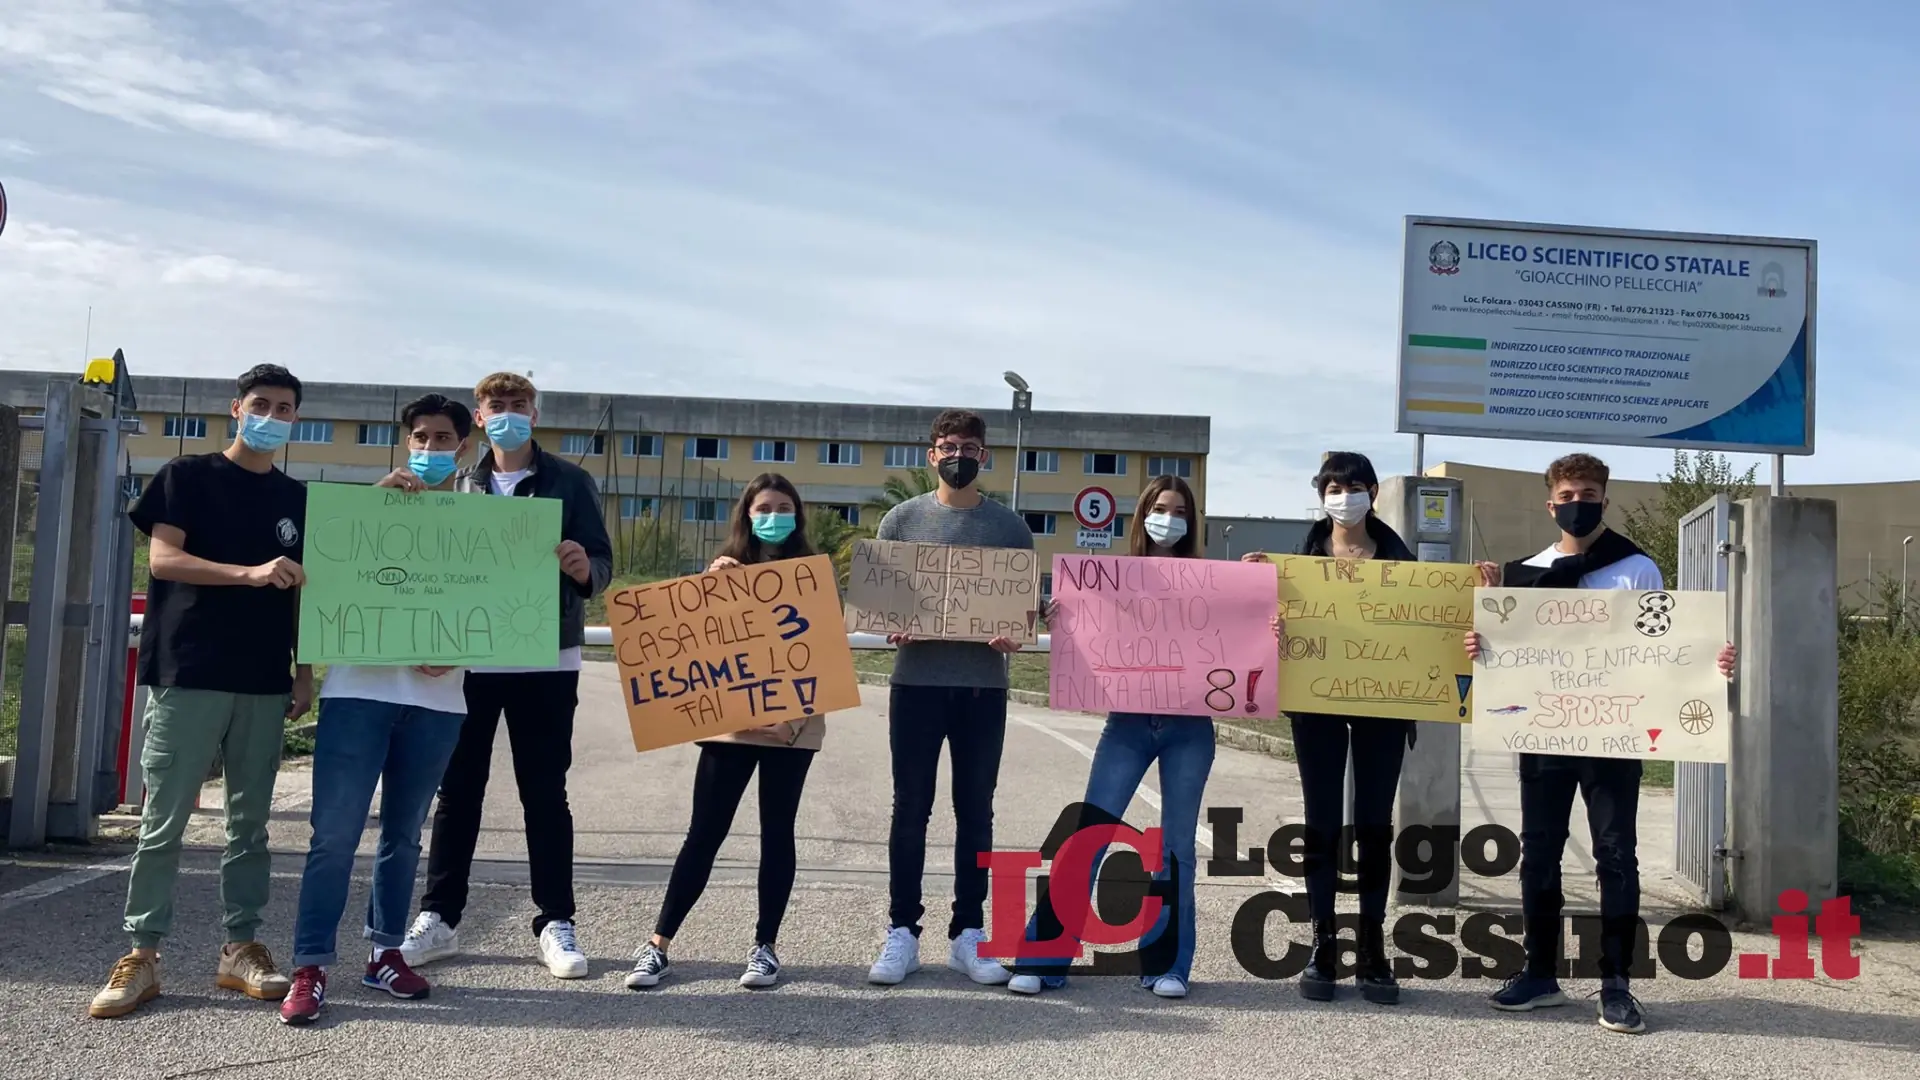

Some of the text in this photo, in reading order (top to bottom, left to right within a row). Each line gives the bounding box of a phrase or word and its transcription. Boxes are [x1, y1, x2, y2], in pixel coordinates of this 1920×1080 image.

[1468, 242, 1750, 276] LICEO SCIENTIFICO STATALE
[1464, 296, 1480, 304] Loc.
[1482, 297, 1512, 306] Folcara
[1518, 300, 1544, 308] 03043
[1546, 300, 1582, 310] CASSINO
[1584, 302, 1600, 312] (FR)
[1610, 304, 1624, 313] Tel.
[1626, 306, 1674, 316] 0776.21323
[1681, 308, 1695, 317] Fax
[1696, 310, 1750, 321] 0776.300425
[1491, 341, 1690, 362] INDIRIZZO LICEO SCIENTIFICO TRADIZIONALE
[1490, 360, 1690, 380] INDIRIZZO LICEO SCIENTIFICO TRADIZIONALE
[1490, 388, 1710, 409] INDIRIZZO LICEO SCIENTIFICO SCIENZE APPLICATE
[1489, 406, 1668, 425] INDIRIZZO LICEO SCIENTIFICO SPORTIVO
[384, 492, 456, 507] DATEMI UNA
[1089, 499, 1100, 519] 5
[314, 516, 498, 566] CINQUINA
[854, 542, 902, 566] ALLE
[993, 552, 1030, 572] HO
[358, 570, 376, 582] MA
[380, 571, 402, 582] NON
[406, 574, 438, 584] VOGLIO
[864, 568, 1032, 596] APPUNTAMENTO
[1059, 558, 1220, 592] NON CI SERVE
[1278, 557, 1296, 579] E
[1315, 558, 1366, 584] TRE
[1408, 566, 1475, 592] L'ORA
[394, 586, 444, 596] FINO ALLA
[614, 563, 818, 626] SE TORNO A
[920, 595, 969, 615] CON
[856, 610, 924, 634] MARIA
[934, 616, 958, 634] DE
[1058, 599, 1101, 636] UN
[1356, 602, 1474, 624] PENNICHELL
[1536, 590, 1676, 638] ALLE 8
[318, 604, 494, 656] MATTINA
[618, 604, 810, 667] CASA ALLE 3
[1058, 636, 1075, 672] A
[1089, 636, 1184, 668] SCUOLA
[1344, 638, 1410, 662] DELLA
[1480, 645, 1692, 670] DOBBIAMO ENTRARE
[630, 642, 810, 706] L'ESAME LO
[1056, 673, 1129, 708] ENTRA
[1138, 672, 1190, 710] ALLE
[674, 690, 724, 727] FAI
